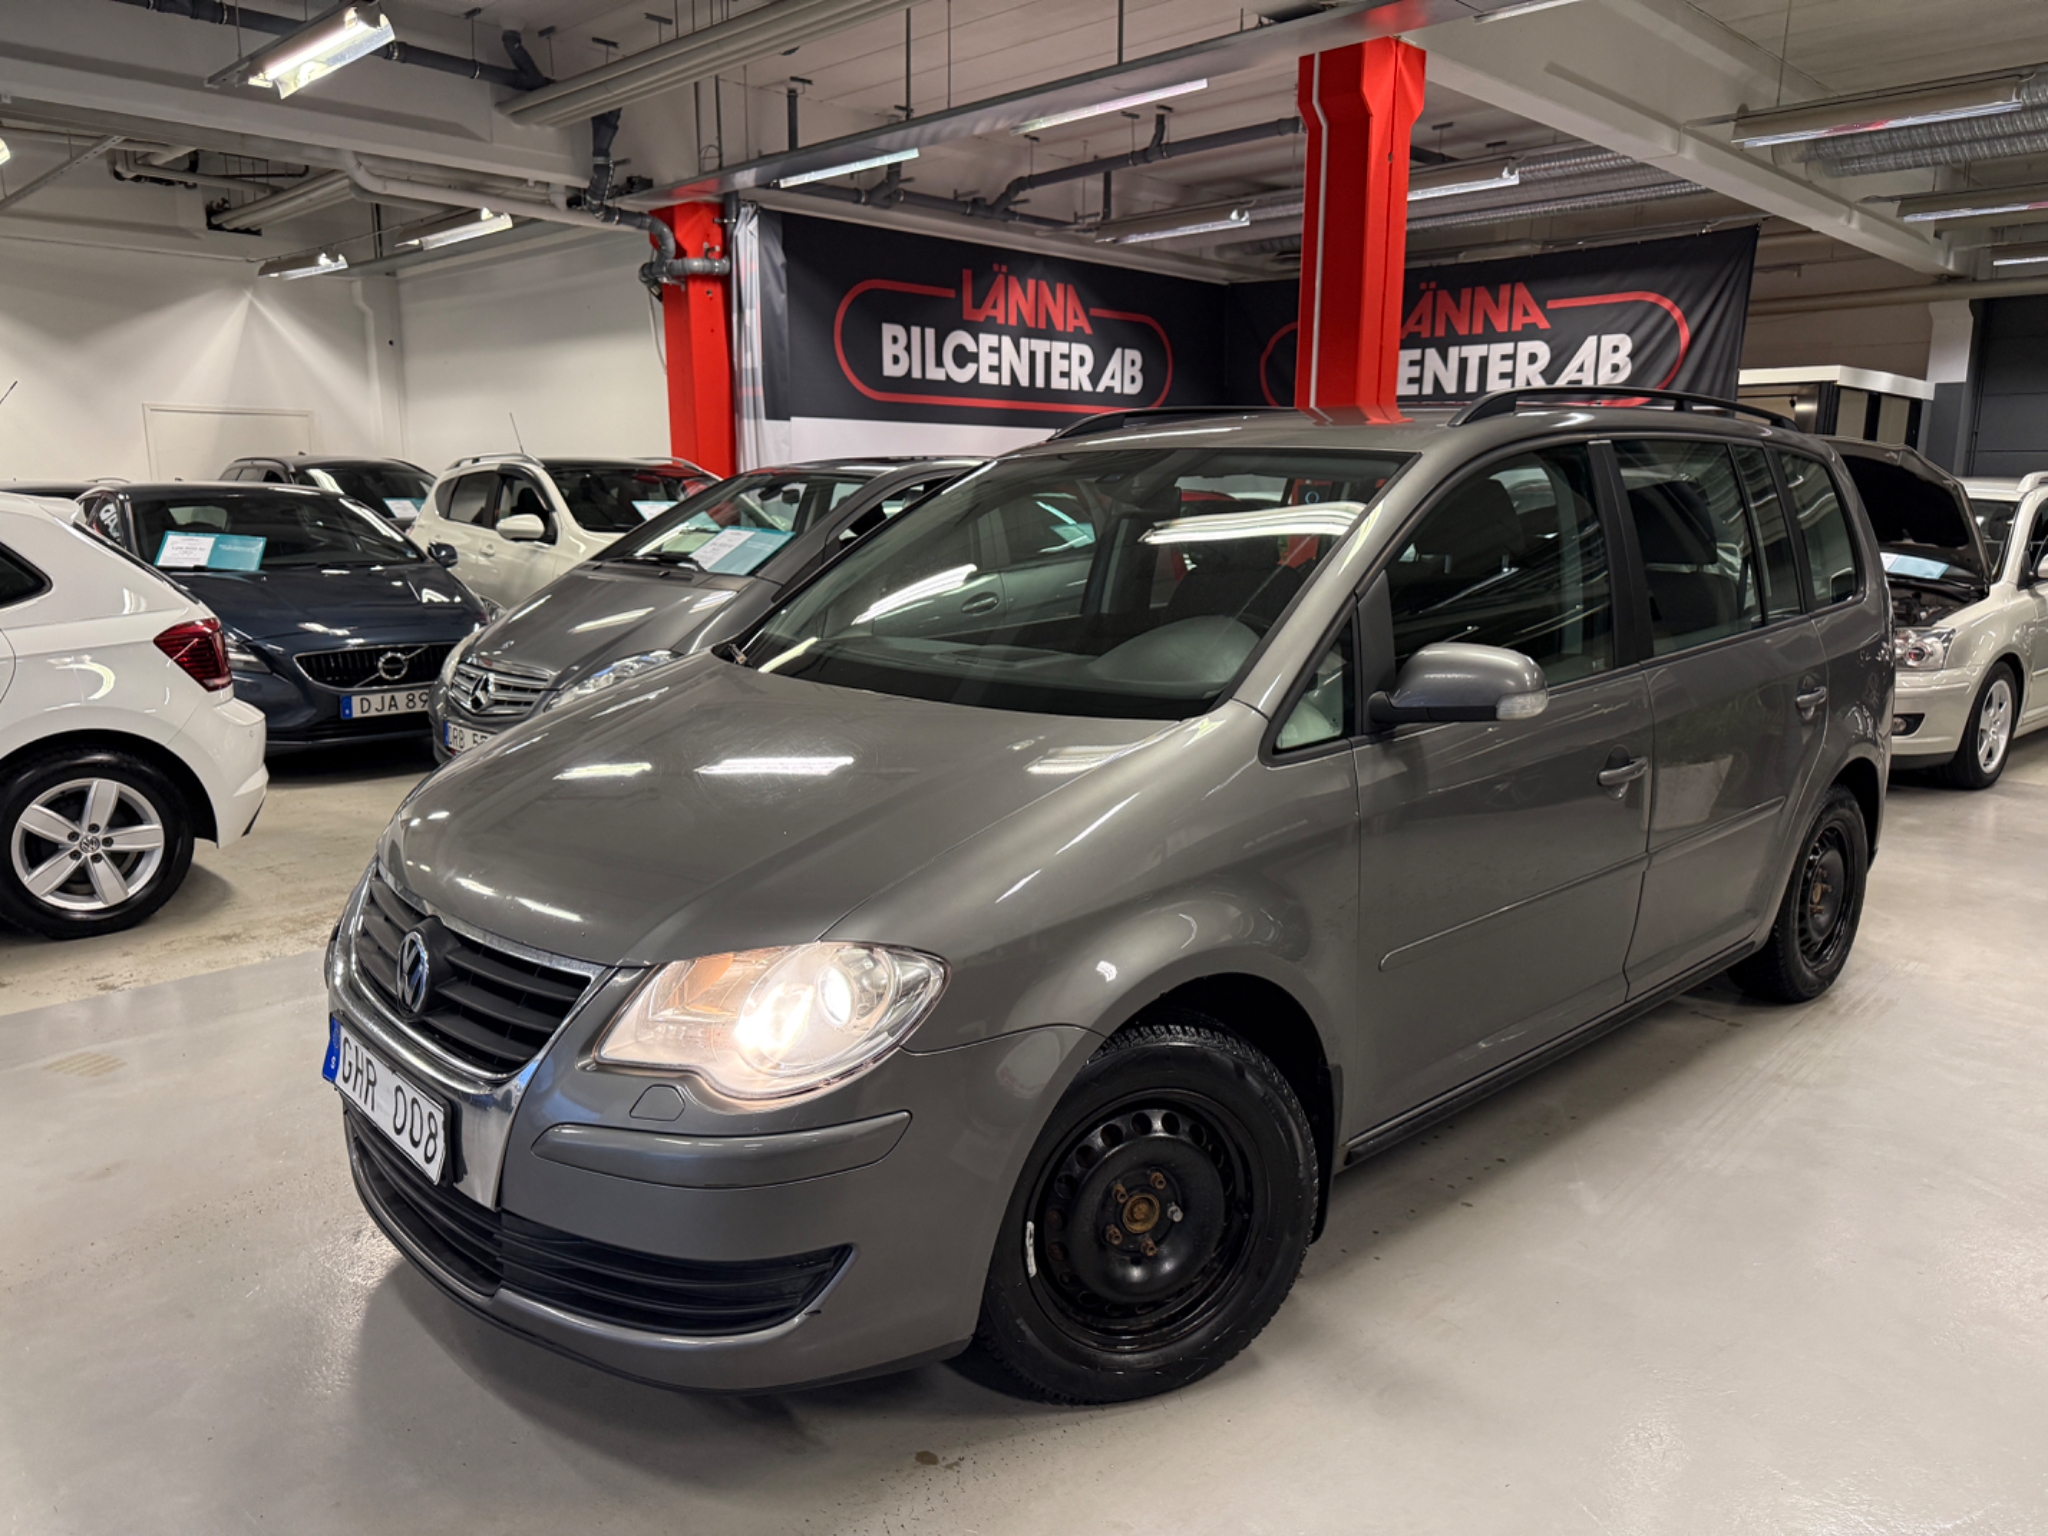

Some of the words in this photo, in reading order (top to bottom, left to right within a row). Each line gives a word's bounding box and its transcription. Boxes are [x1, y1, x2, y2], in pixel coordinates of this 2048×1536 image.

[961, 264, 1093, 335] LÄNNA
[1400, 281, 1551, 340] ÄNNA
[881, 322, 1094, 393] BILCENTER
[1095, 347, 1144, 396] AB
[1396, 339, 1551, 397] ENTER
[1554, 333, 1632, 386] AB
[360, 694, 398, 714] DJA
[405, 692, 430, 710] 89
[342, 1036, 378, 1113] GHR
[392, 1084, 438, 1165] 008
